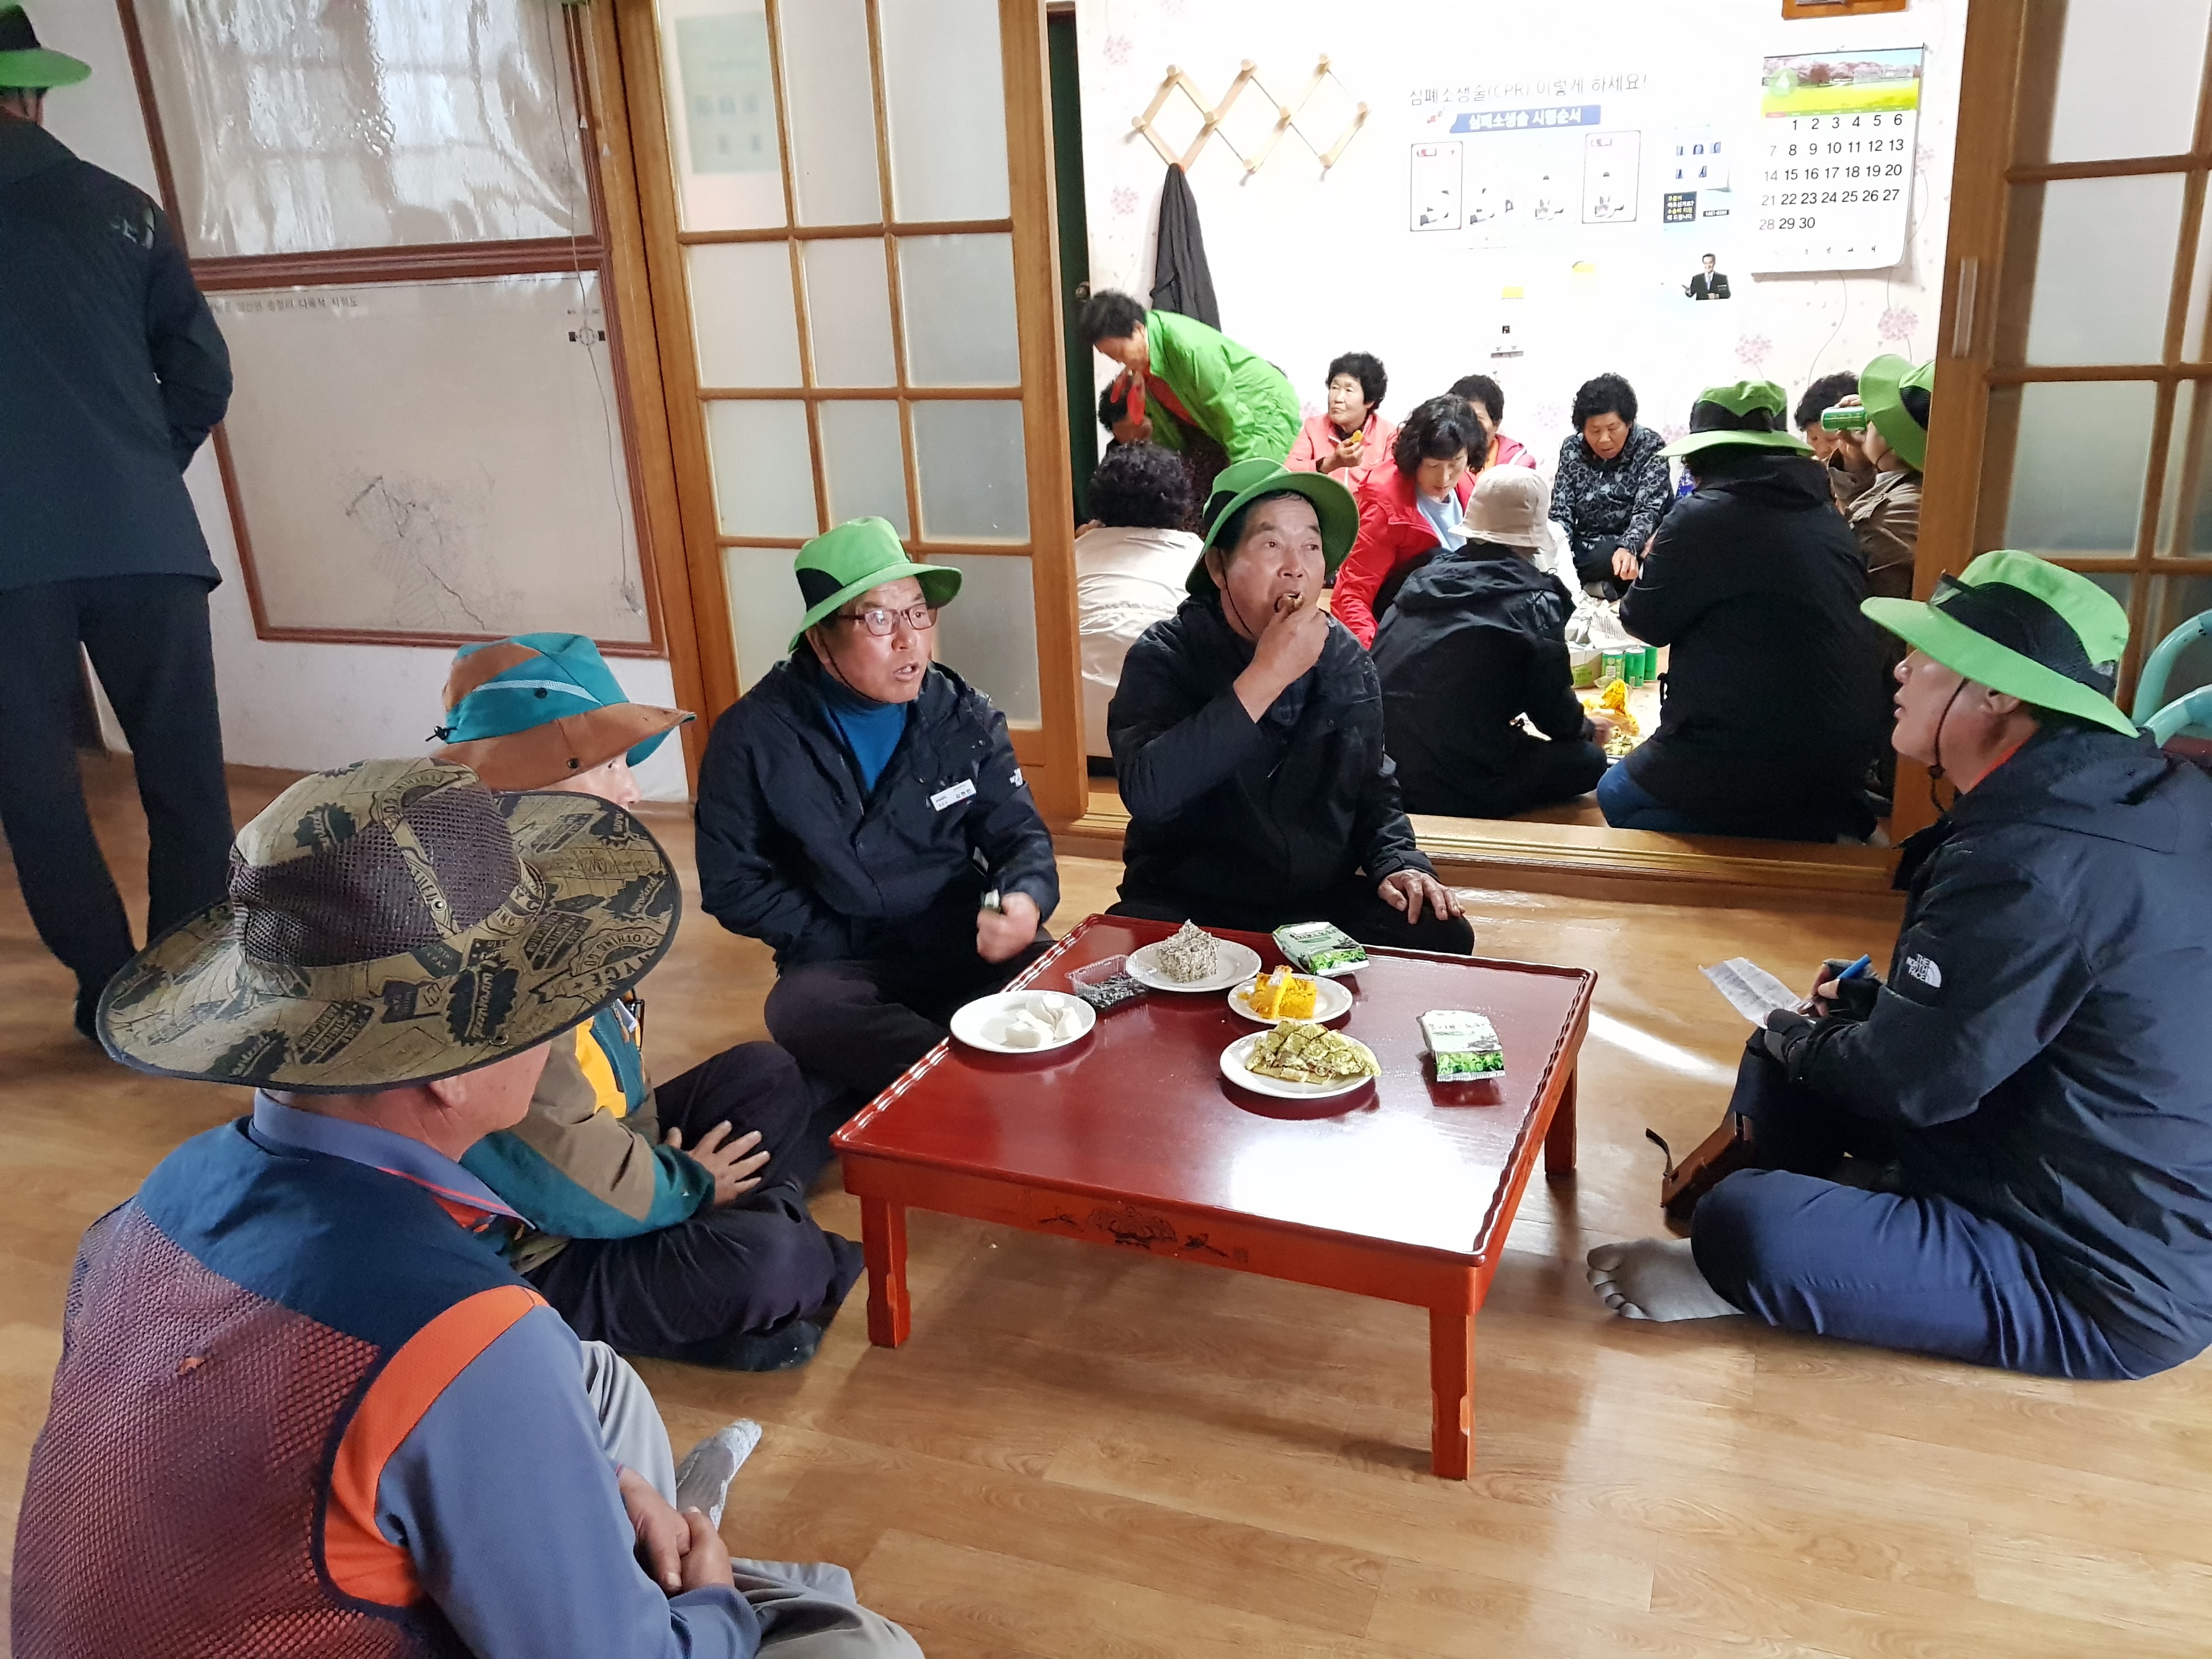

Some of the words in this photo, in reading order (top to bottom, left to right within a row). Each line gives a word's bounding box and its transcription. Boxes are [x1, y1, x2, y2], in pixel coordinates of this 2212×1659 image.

[1410, 82, 1529, 106] 심폐소생술(CPR)
[1537, 77, 1584, 97] 이렇게
[1592, 73, 1646, 92] 하세요!
[1469, 111, 1530, 131] 심폐소생술
[1532, 107, 1582, 125] 시행순서
[1792, 119, 1797, 131] 1
[1811, 118, 1819, 129] 2
[1832, 117, 1839, 129] 3
[1852, 116, 1860, 127] 4
[1874, 115, 1882, 127] 5
[1894, 113, 1903, 126] 6
[1769, 145, 1778, 157] 7
[1788, 144, 1797, 156] 8
[1809, 143, 1818, 155] 9
[1827, 142, 1842, 154] 10
[1848, 141, 1860, 153] 11
[1868, 139, 1883, 152] 12
[1889, 138, 1904, 151] 13
[1764, 170, 1778, 182] 14
[1785, 168, 1798, 180] 15
[1805, 168, 1819, 180] 16
[1825, 167, 1839, 179] 17
[1845, 166, 1860, 178] 18
[1866, 165, 1881, 177] 19
[1884, 163, 1902, 176] 20
[1762, 195, 1775, 206] 21
[1781, 193, 1797, 205] 22
[1801, 192, 1817, 205] 23
[1821, 191, 1837, 204] 24
[1841, 190, 1858, 202] 25
[1862, 190, 1879, 202] 26
[1883, 189, 1900, 201] 27
[1759, 219, 1775, 230] 28
[1779, 218, 1795, 229] 29
[1799, 217, 1815, 229] 30
[596, 934, 658, 950] CLOTHING
[1917, 953, 1930, 966] THE
[1908, 967, 1926, 981] FACE
